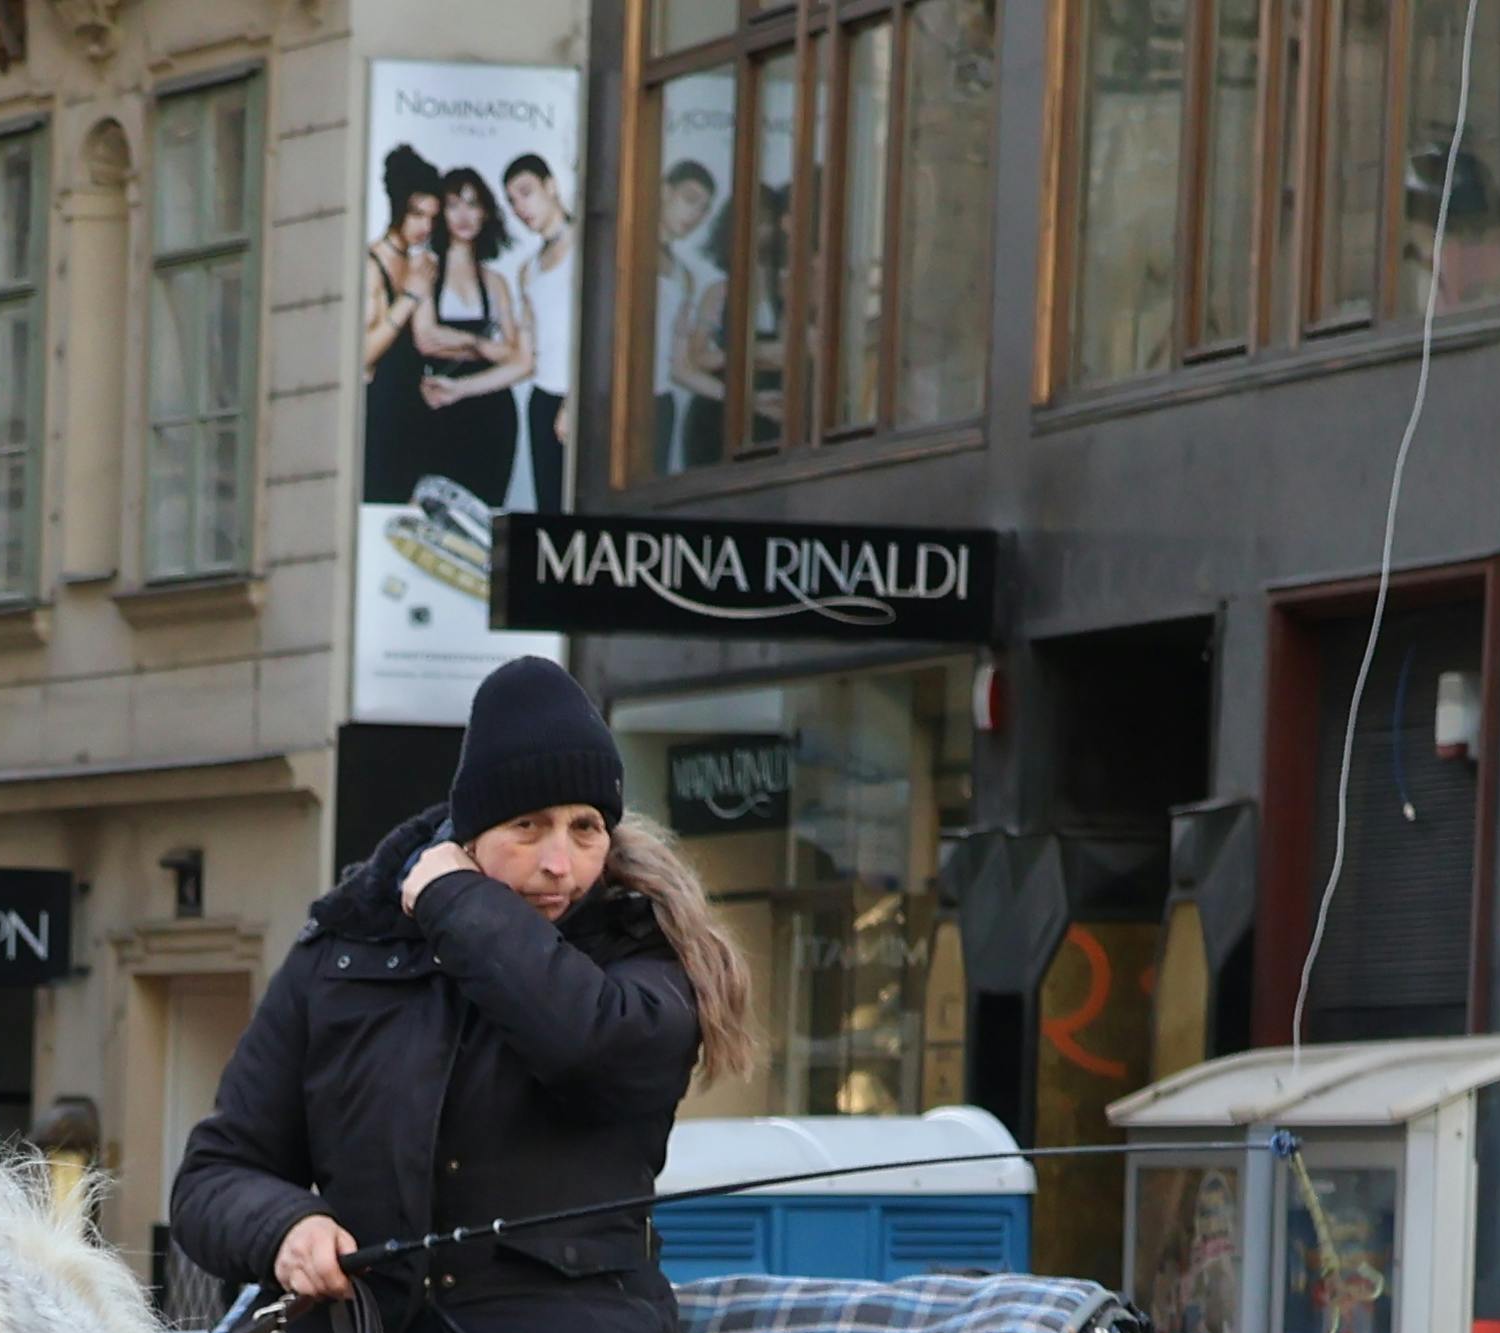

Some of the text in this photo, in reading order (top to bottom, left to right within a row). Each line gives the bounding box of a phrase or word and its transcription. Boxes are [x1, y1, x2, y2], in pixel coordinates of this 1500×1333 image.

[395, 87, 555, 131] NOMINATION
[536, 528, 970, 606] MARINA RINALDI
